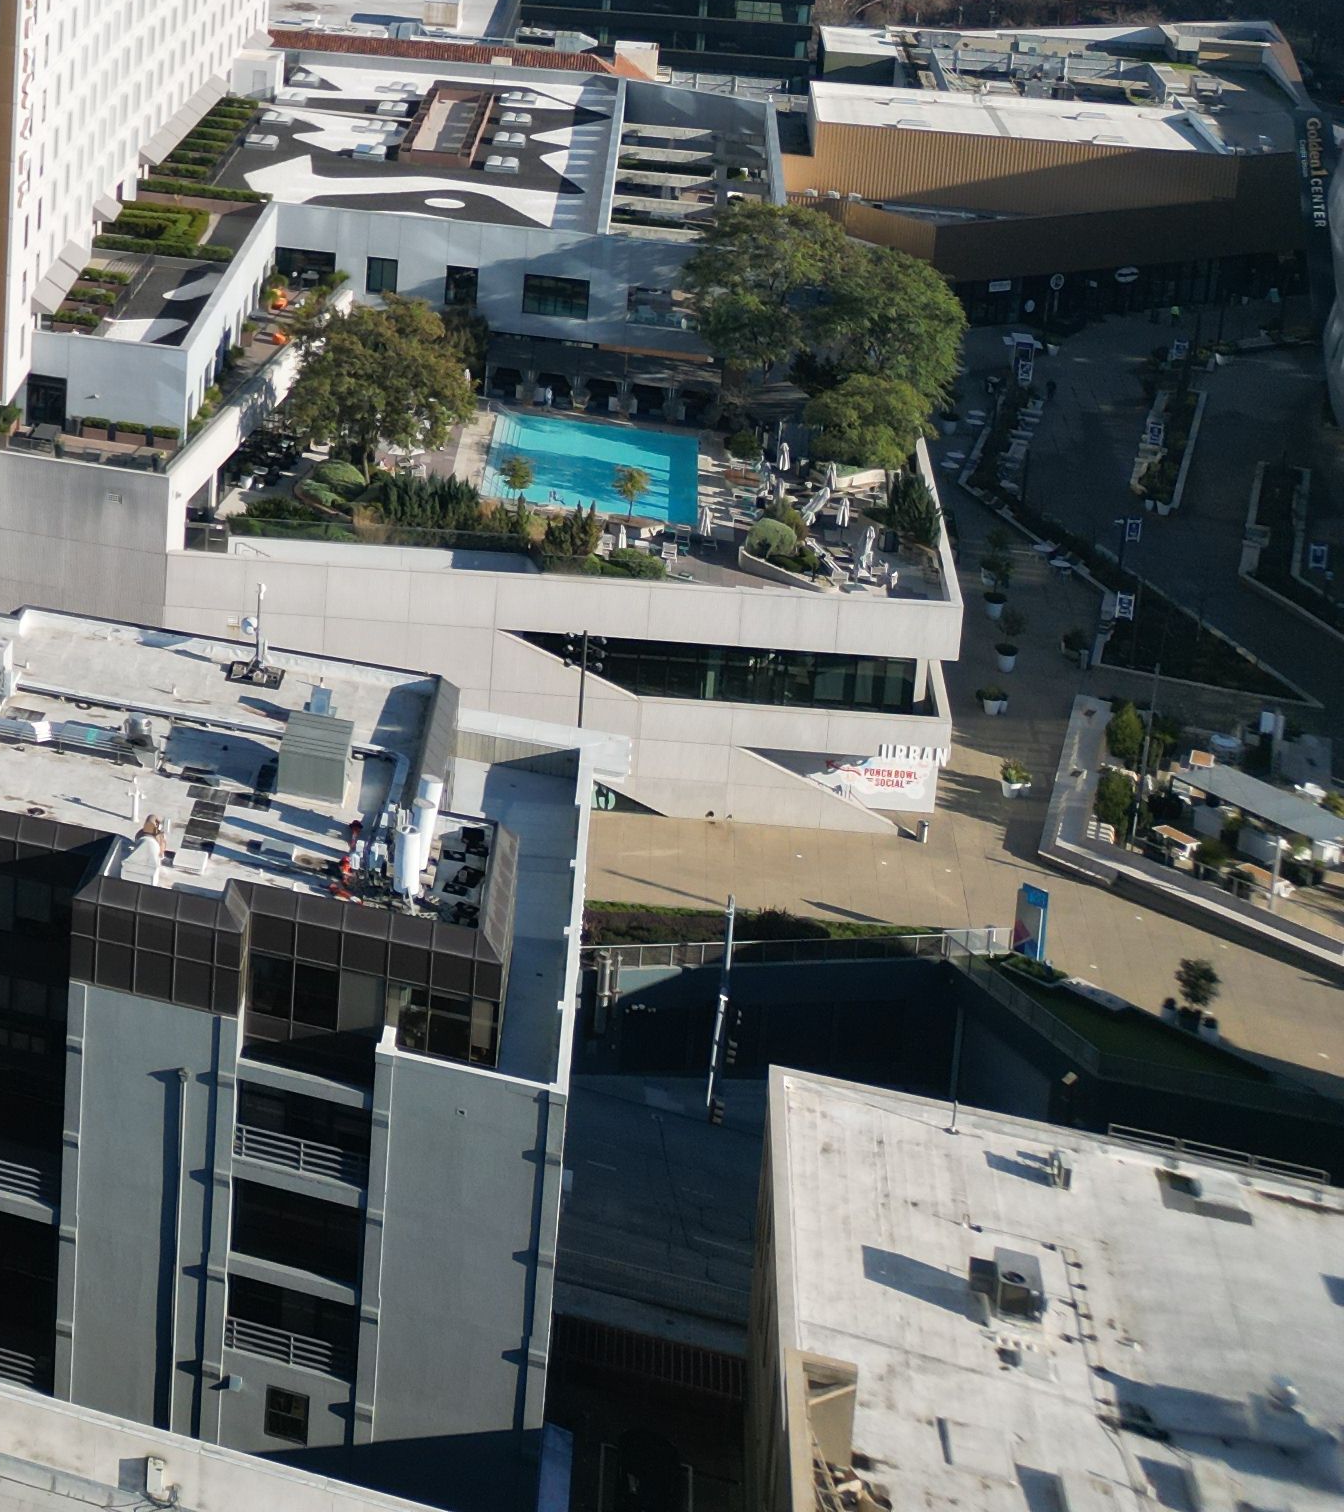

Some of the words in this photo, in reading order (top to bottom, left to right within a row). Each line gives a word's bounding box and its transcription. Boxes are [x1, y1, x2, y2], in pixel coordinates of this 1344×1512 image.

[1311, 178, 1327, 228] CENTER
[879, 743, 949, 768] URBAN
[863, 768, 893, 779] PUNCH
[894, 770, 918, 780] BOWL
[874, 777, 906, 789] SOCIAL
